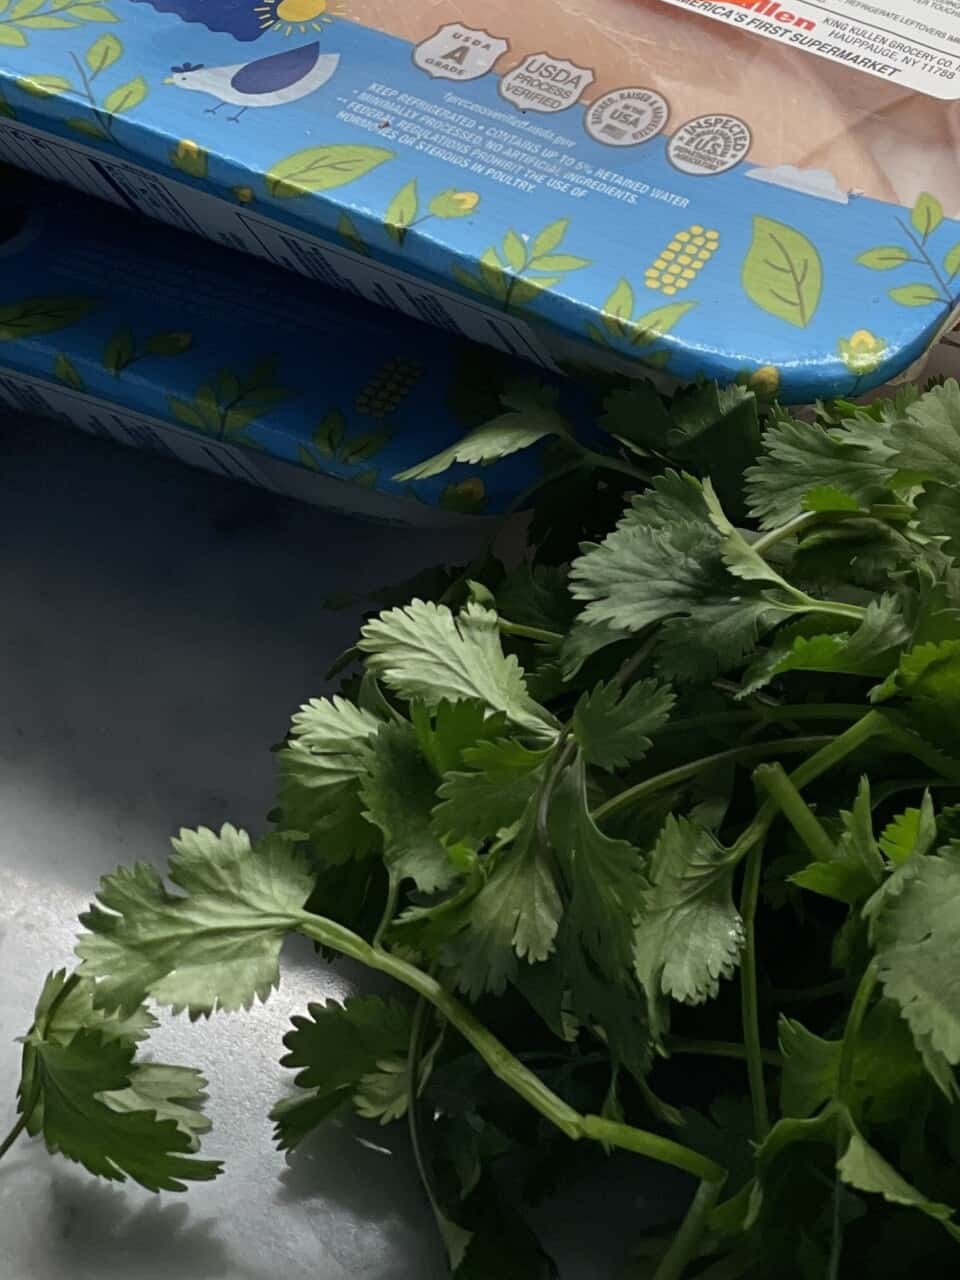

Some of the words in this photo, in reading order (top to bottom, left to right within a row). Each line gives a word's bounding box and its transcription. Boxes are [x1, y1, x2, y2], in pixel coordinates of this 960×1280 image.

[452, 31, 491, 52] USDA
[822, 17, 849, 31] KING
[848, 25, 888, 45] KULLEN
[887, 39, 937, 62] GROCERY
[899, 17, 947, 38] LEFTOVERS
[439, 45, 471, 66] A
[745, 17, 792, 37] FIRST
[788, 32, 901, 76] SUPERMARKET
[827, 29, 898, 61] HAUPPAUGE,
[900, 55, 920, 67] NY
[920, 62, 956, 80] 11788
[424, 56, 466, 76] GRADE
[525, 58, 582, 90] USDA
[504, 82, 562, 110] VERIFIED
[512, 72, 573, 99] PROCESS
[608, 108, 641, 129] USA
[684, 116, 746, 153] INSPECTED
[367, 82, 398, 96] KEEP
[396, 93, 476, 127] REFRIGERATED
[485, 127, 541, 153] CONTAINS
[540, 147, 558, 159] UP
[558, 153, 575, 166] TO
[594, 168, 649, 193] RETAINED
[649, 187, 689, 208] WATER
[396, 120, 470, 153] REGULATIONS
[469, 148, 523, 174] PROHIBIT
[523, 168, 547, 183] THE
[545, 177, 570, 192] USE
[569, 186, 588, 197] OF
[397, 133, 418, 146] OR
[415, 141, 471, 167] STEROIDS
[469, 162, 485, 173] IN
[484, 139, 503, 152] NO
[501, 147, 561, 176] ARTIFICIAL
